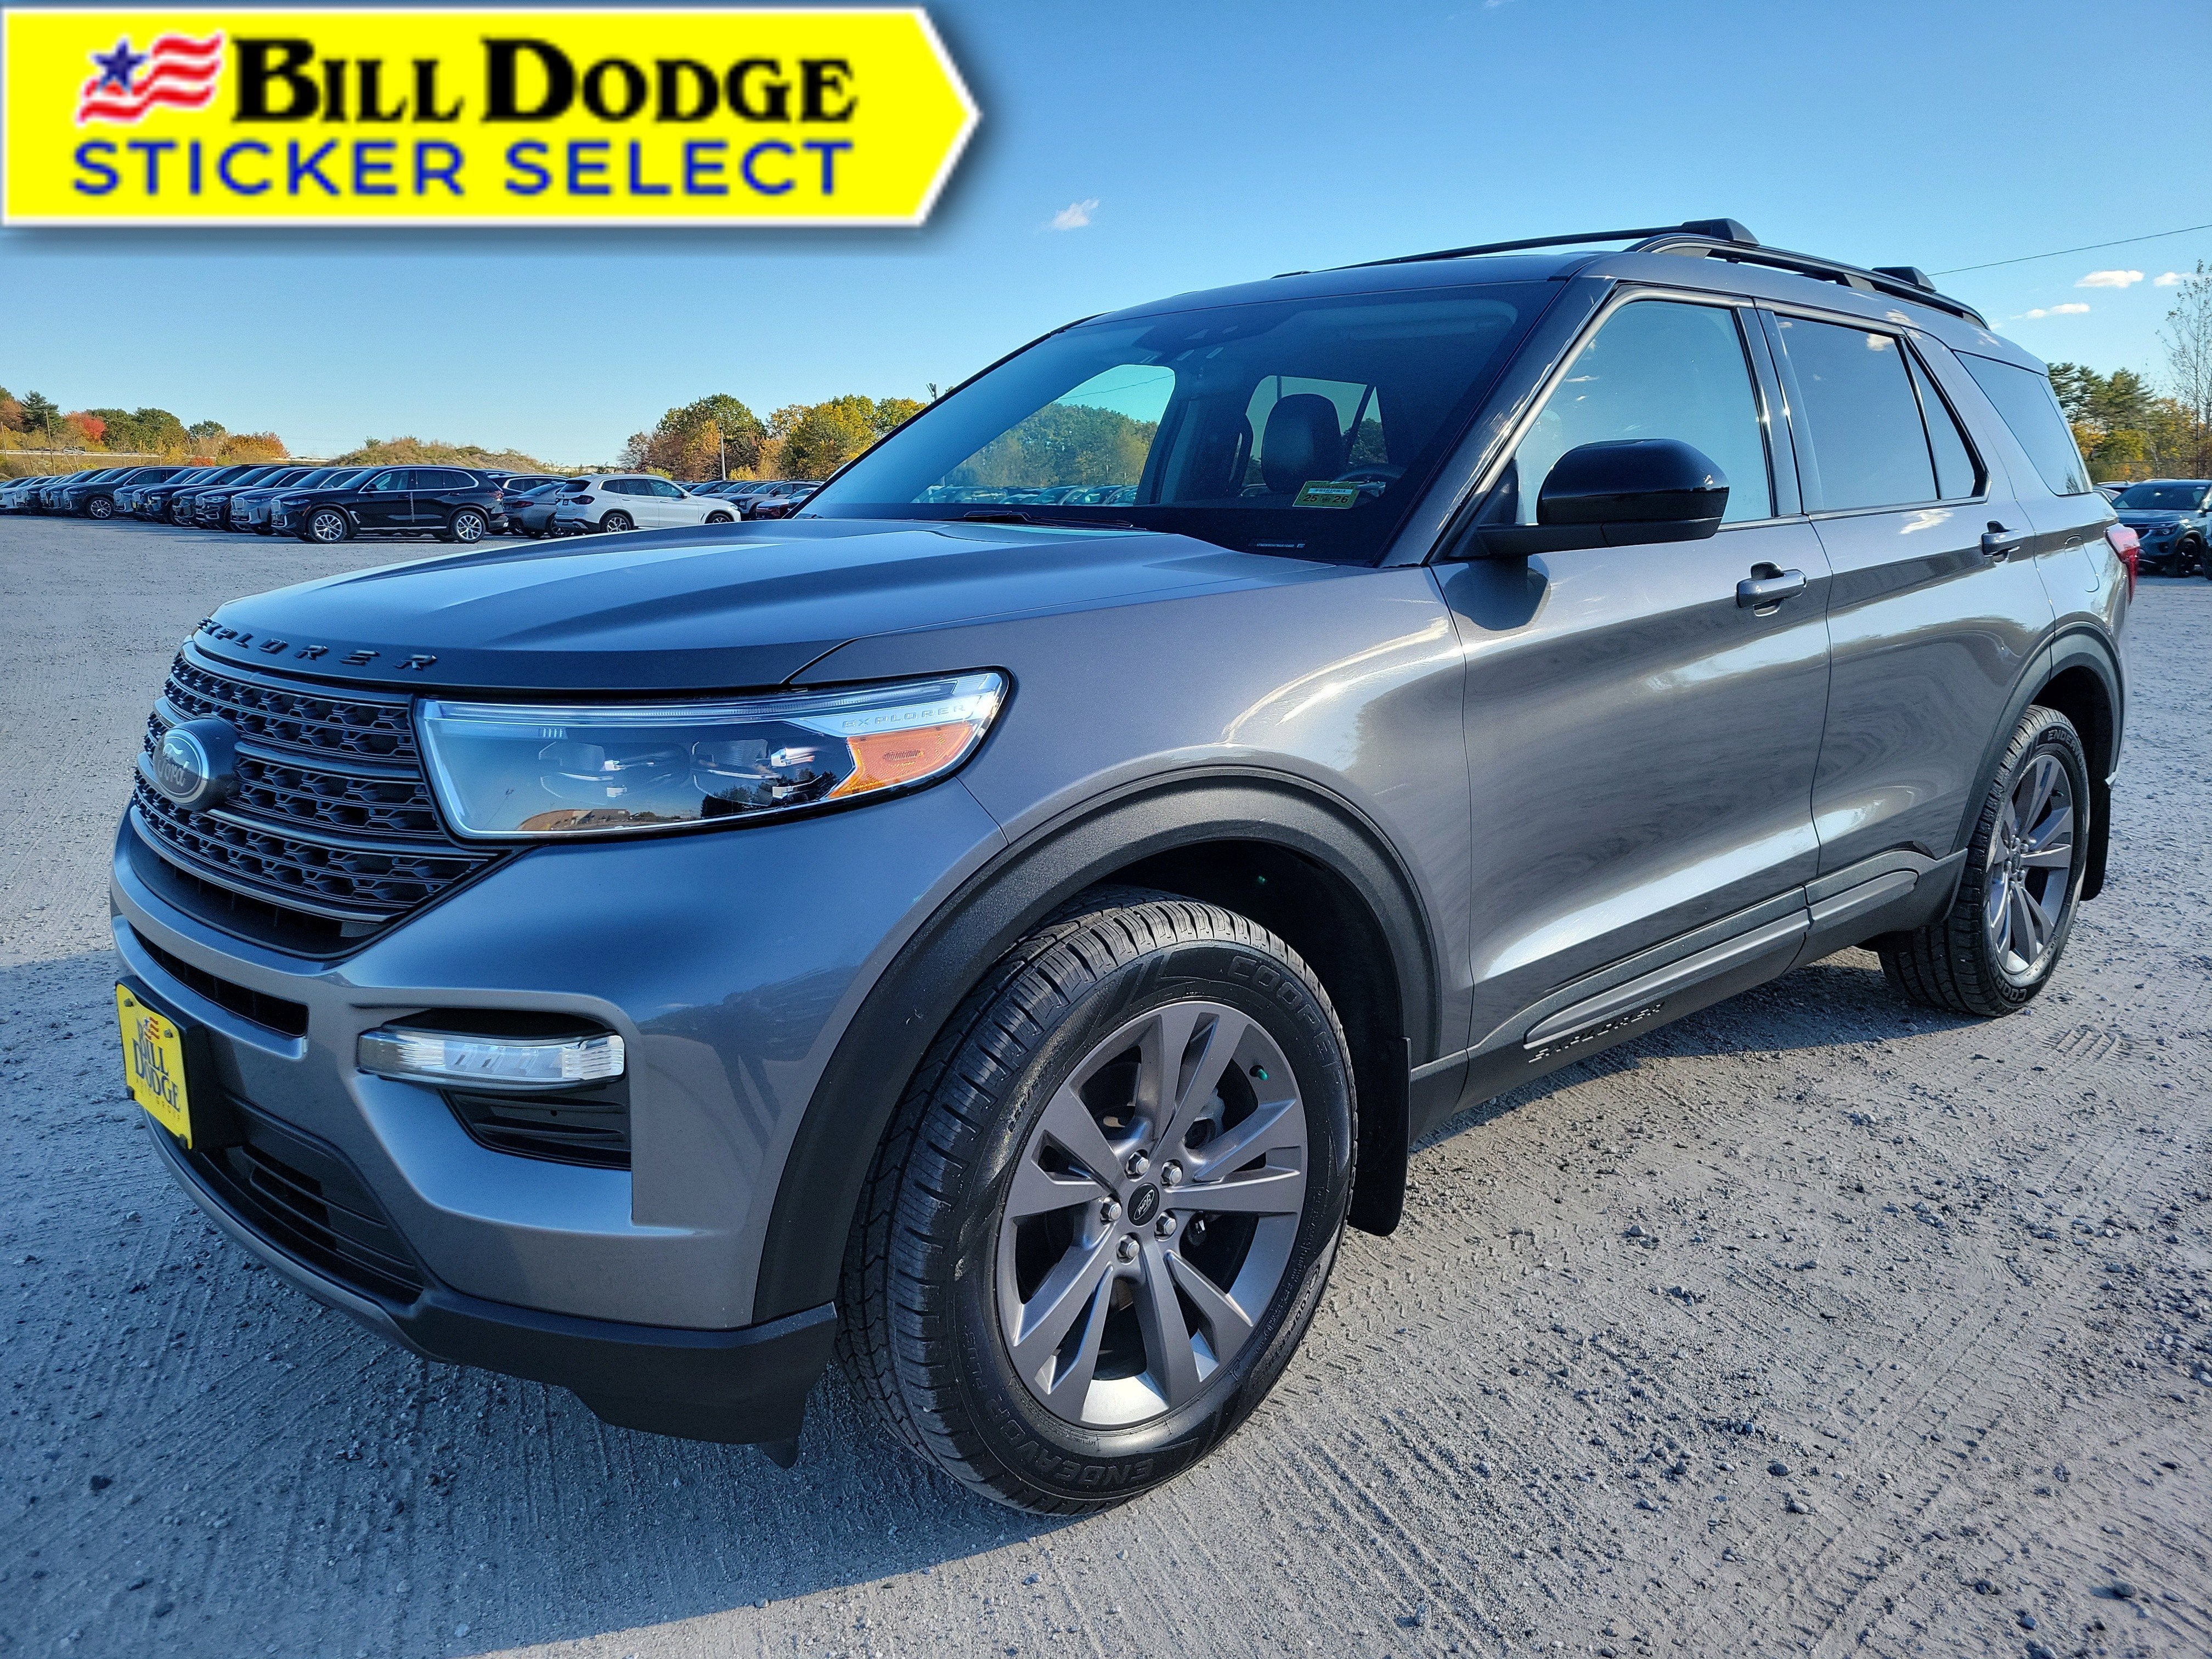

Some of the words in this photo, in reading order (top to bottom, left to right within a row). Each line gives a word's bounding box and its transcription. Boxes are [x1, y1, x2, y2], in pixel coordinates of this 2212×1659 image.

[1302, 494, 1319, 503] 25
[1332, 495, 1350, 504] 26
[842, 704, 966, 729] EXPLORER
